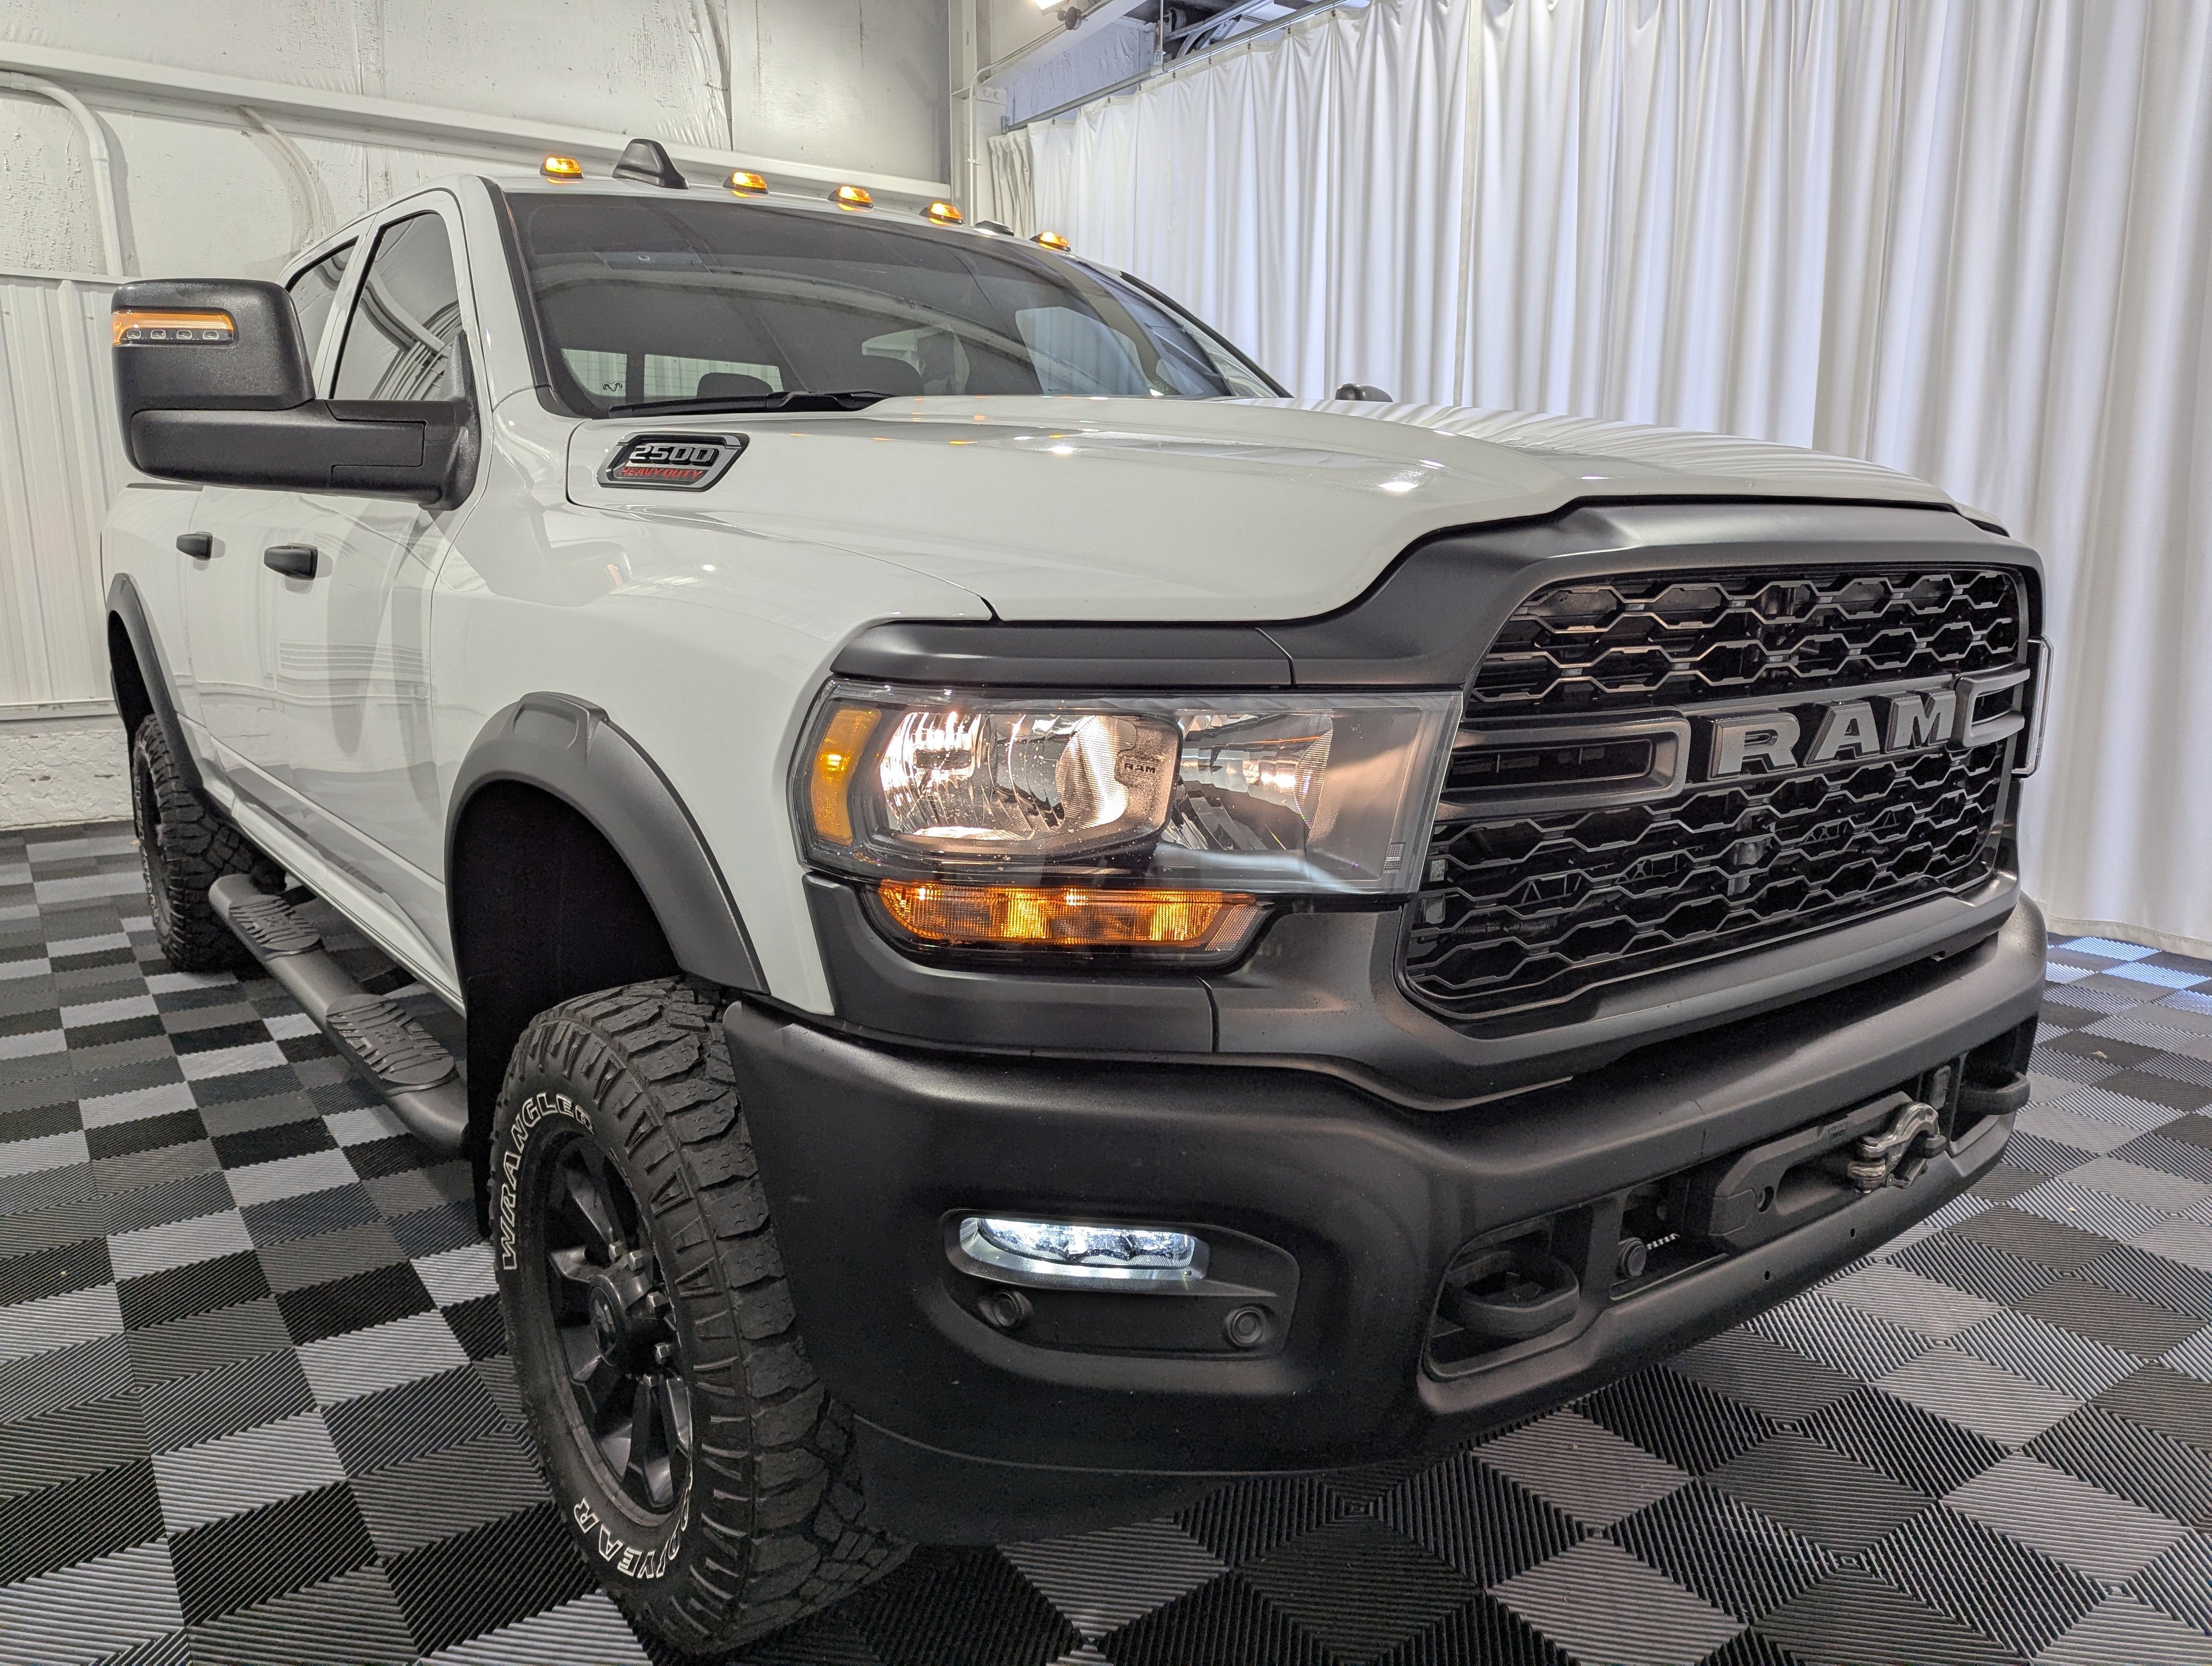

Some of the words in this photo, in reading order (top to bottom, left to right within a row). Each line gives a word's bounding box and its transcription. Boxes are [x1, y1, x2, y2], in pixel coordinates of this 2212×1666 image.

[629, 445, 718, 465] 2500
[620, 467, 662, 476] HEAVY
[662, 469, 703, 479] DUTY
[1707, 689, 1956, 781] RAM
[1124, 762, 1156, 774] RAM
[500, 1091, 595, 1271] WRANGLER
